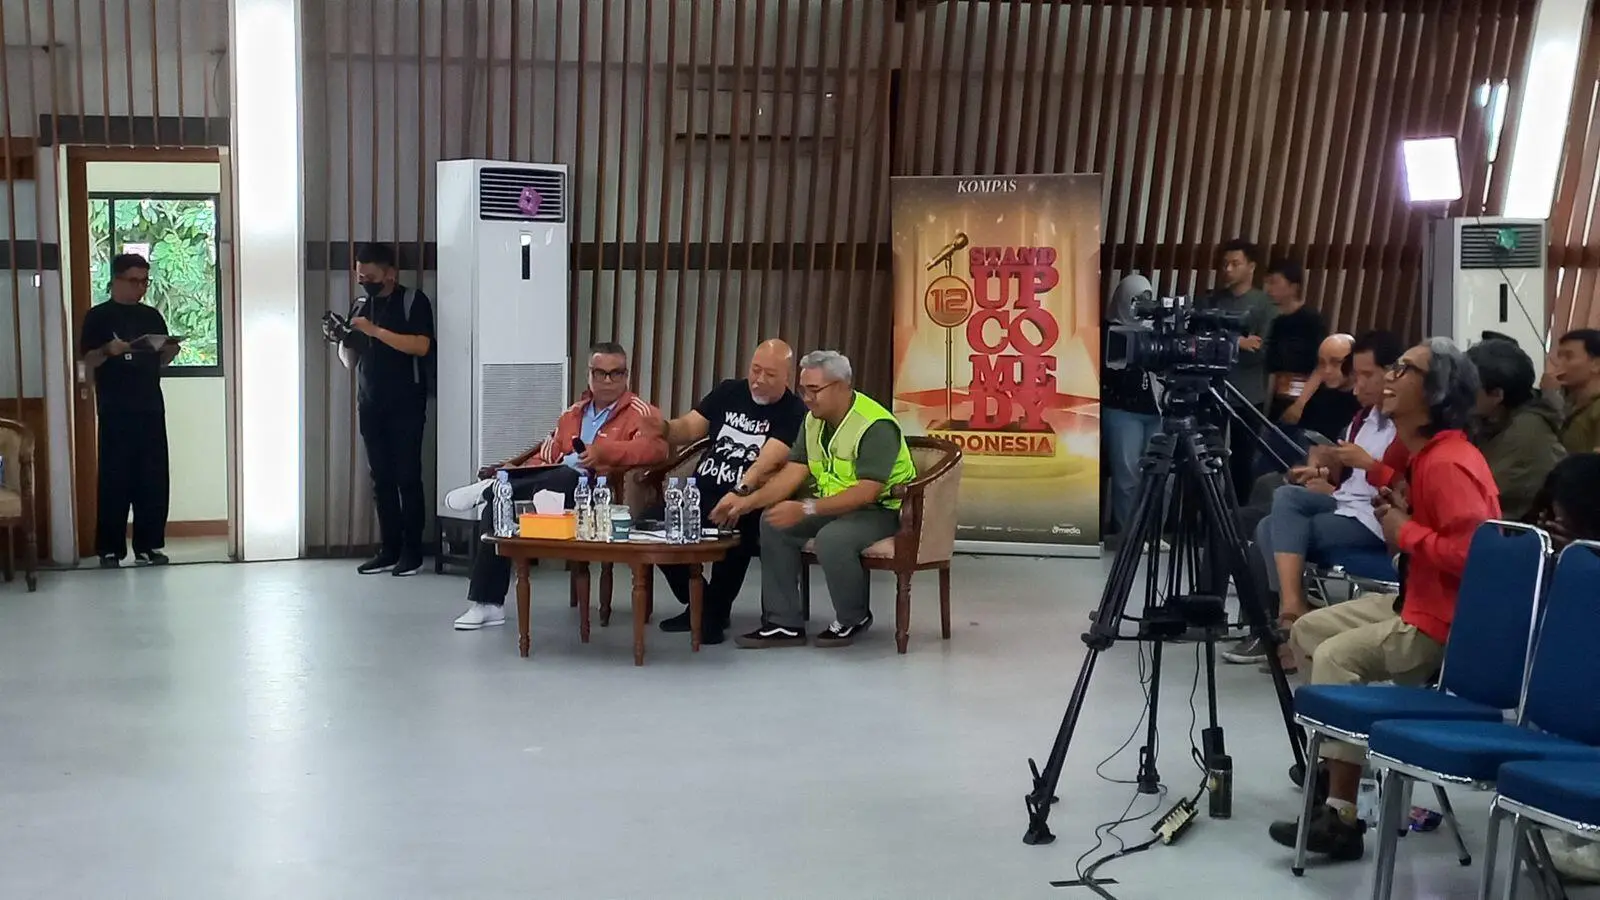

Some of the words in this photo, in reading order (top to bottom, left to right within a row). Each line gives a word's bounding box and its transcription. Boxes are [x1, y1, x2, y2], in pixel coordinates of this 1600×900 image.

[957, 179, 1017, 193] KOMPAS
[969, 246, 1057, 266] STAND
[969, 265, 1060, 310] UP
[930, 288, 968, 313] 12
